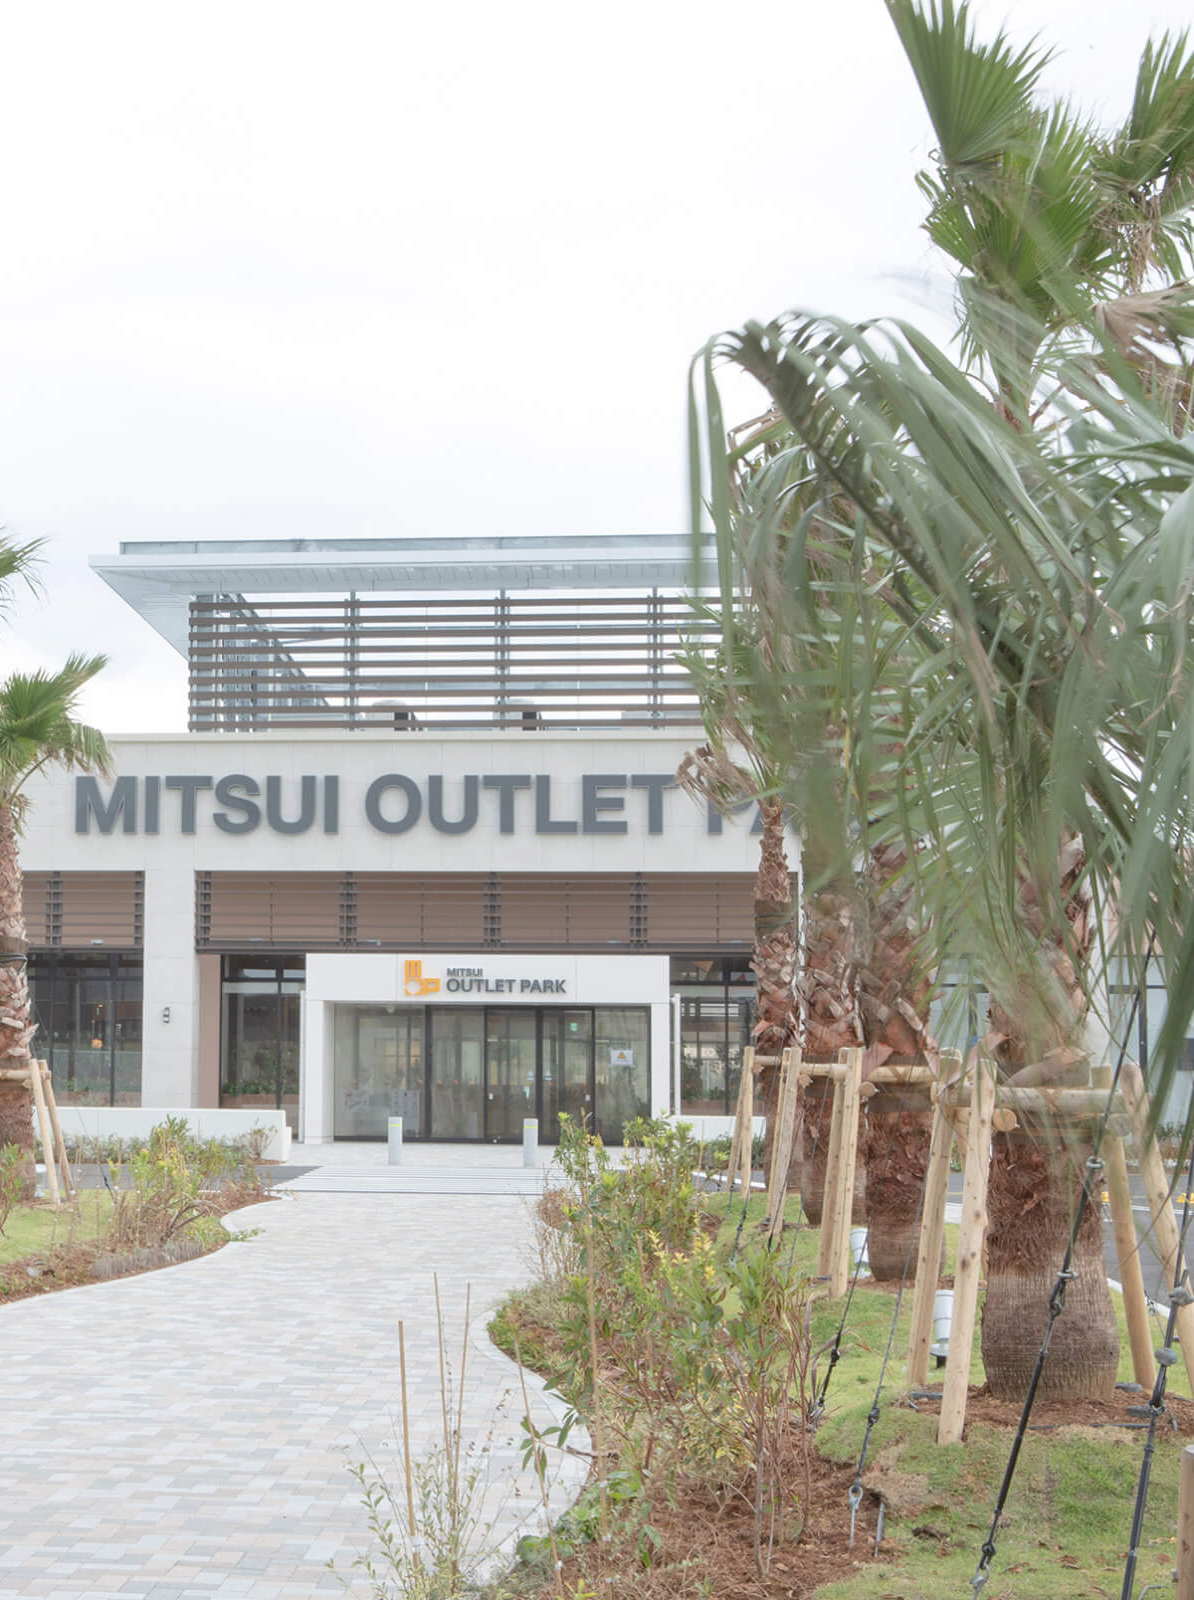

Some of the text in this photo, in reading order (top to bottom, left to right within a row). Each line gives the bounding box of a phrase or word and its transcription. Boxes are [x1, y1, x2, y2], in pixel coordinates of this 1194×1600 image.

[75, 774, 338, 835] MITSUI
[365, 774, 679, 835] OUTLET
[447, 968, 483, 977] MITSUI
[446, 978, 567, 993] OUTLET PARK
